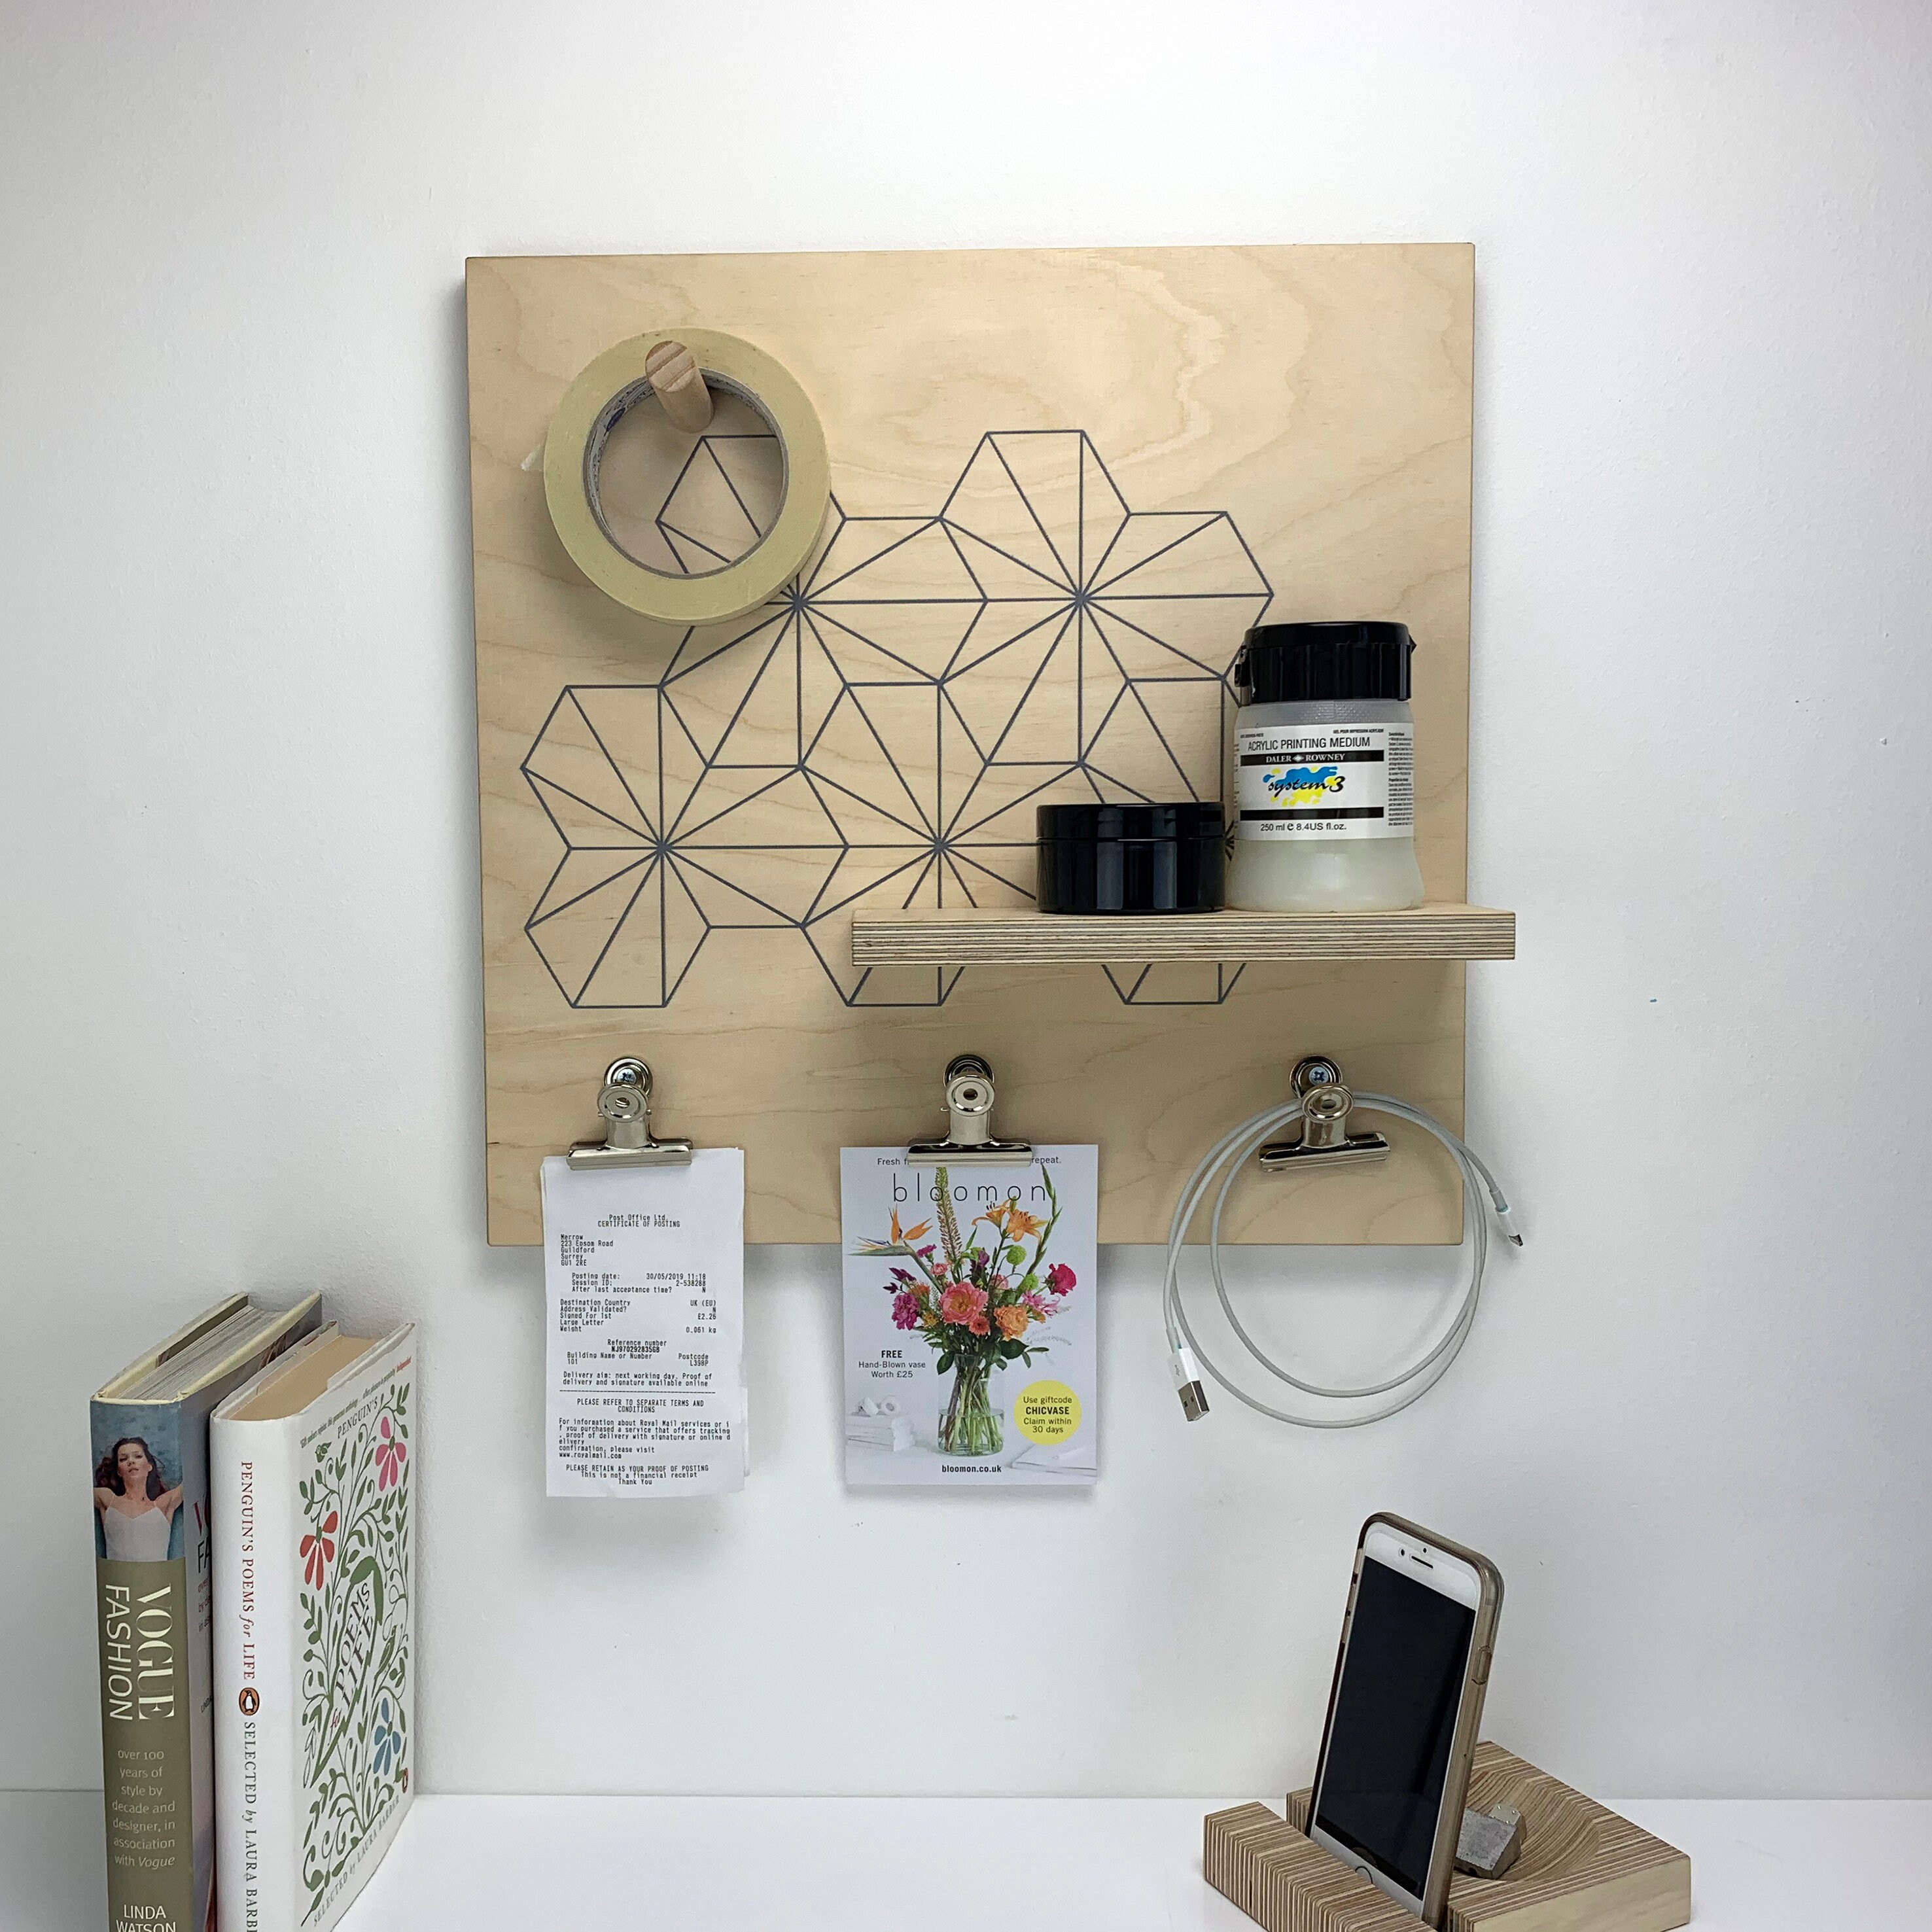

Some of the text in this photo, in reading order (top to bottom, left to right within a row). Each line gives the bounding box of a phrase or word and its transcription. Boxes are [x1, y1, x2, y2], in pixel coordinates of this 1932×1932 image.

[1248, 737, 1370, 751] ACRYLIC PRINTING MEDIUM
[1260, 823, 1274, 832] 250
[1296, 822, 1324, 831] 8.4US
[893, 1172, 1046, 1202] bloomon
[1040, 1396, 1072, 1405] giftcode
[1046, 1426, 1064, 1434] days
[241, 1558, 255, 1612] POEMS
[239, 1614, 255, 1637] for
[105, 1585, 133, 1720] FASHION
[136, 1583, 174, 1719] VOGUE
[243, 1643, 255, 1679] LIFE
[118, 1749, 164, 1760] over 100
[120, 1766, 163, 1778] years of
[121, 1785, 163, 1798] style by
[113, 1799, 175, 1814] decade and
[113, 1818, 175, 1834] designer, in
[241, 1722, 258, 1932] SELECTED by LAURA BARB
[113, 1837, 175, 1850] association
[114, 1854, 175, 1870] with Vogue
[124, 1904, 166, 1920] LINDA
[116, 1920, 176, 1932] WATSON
